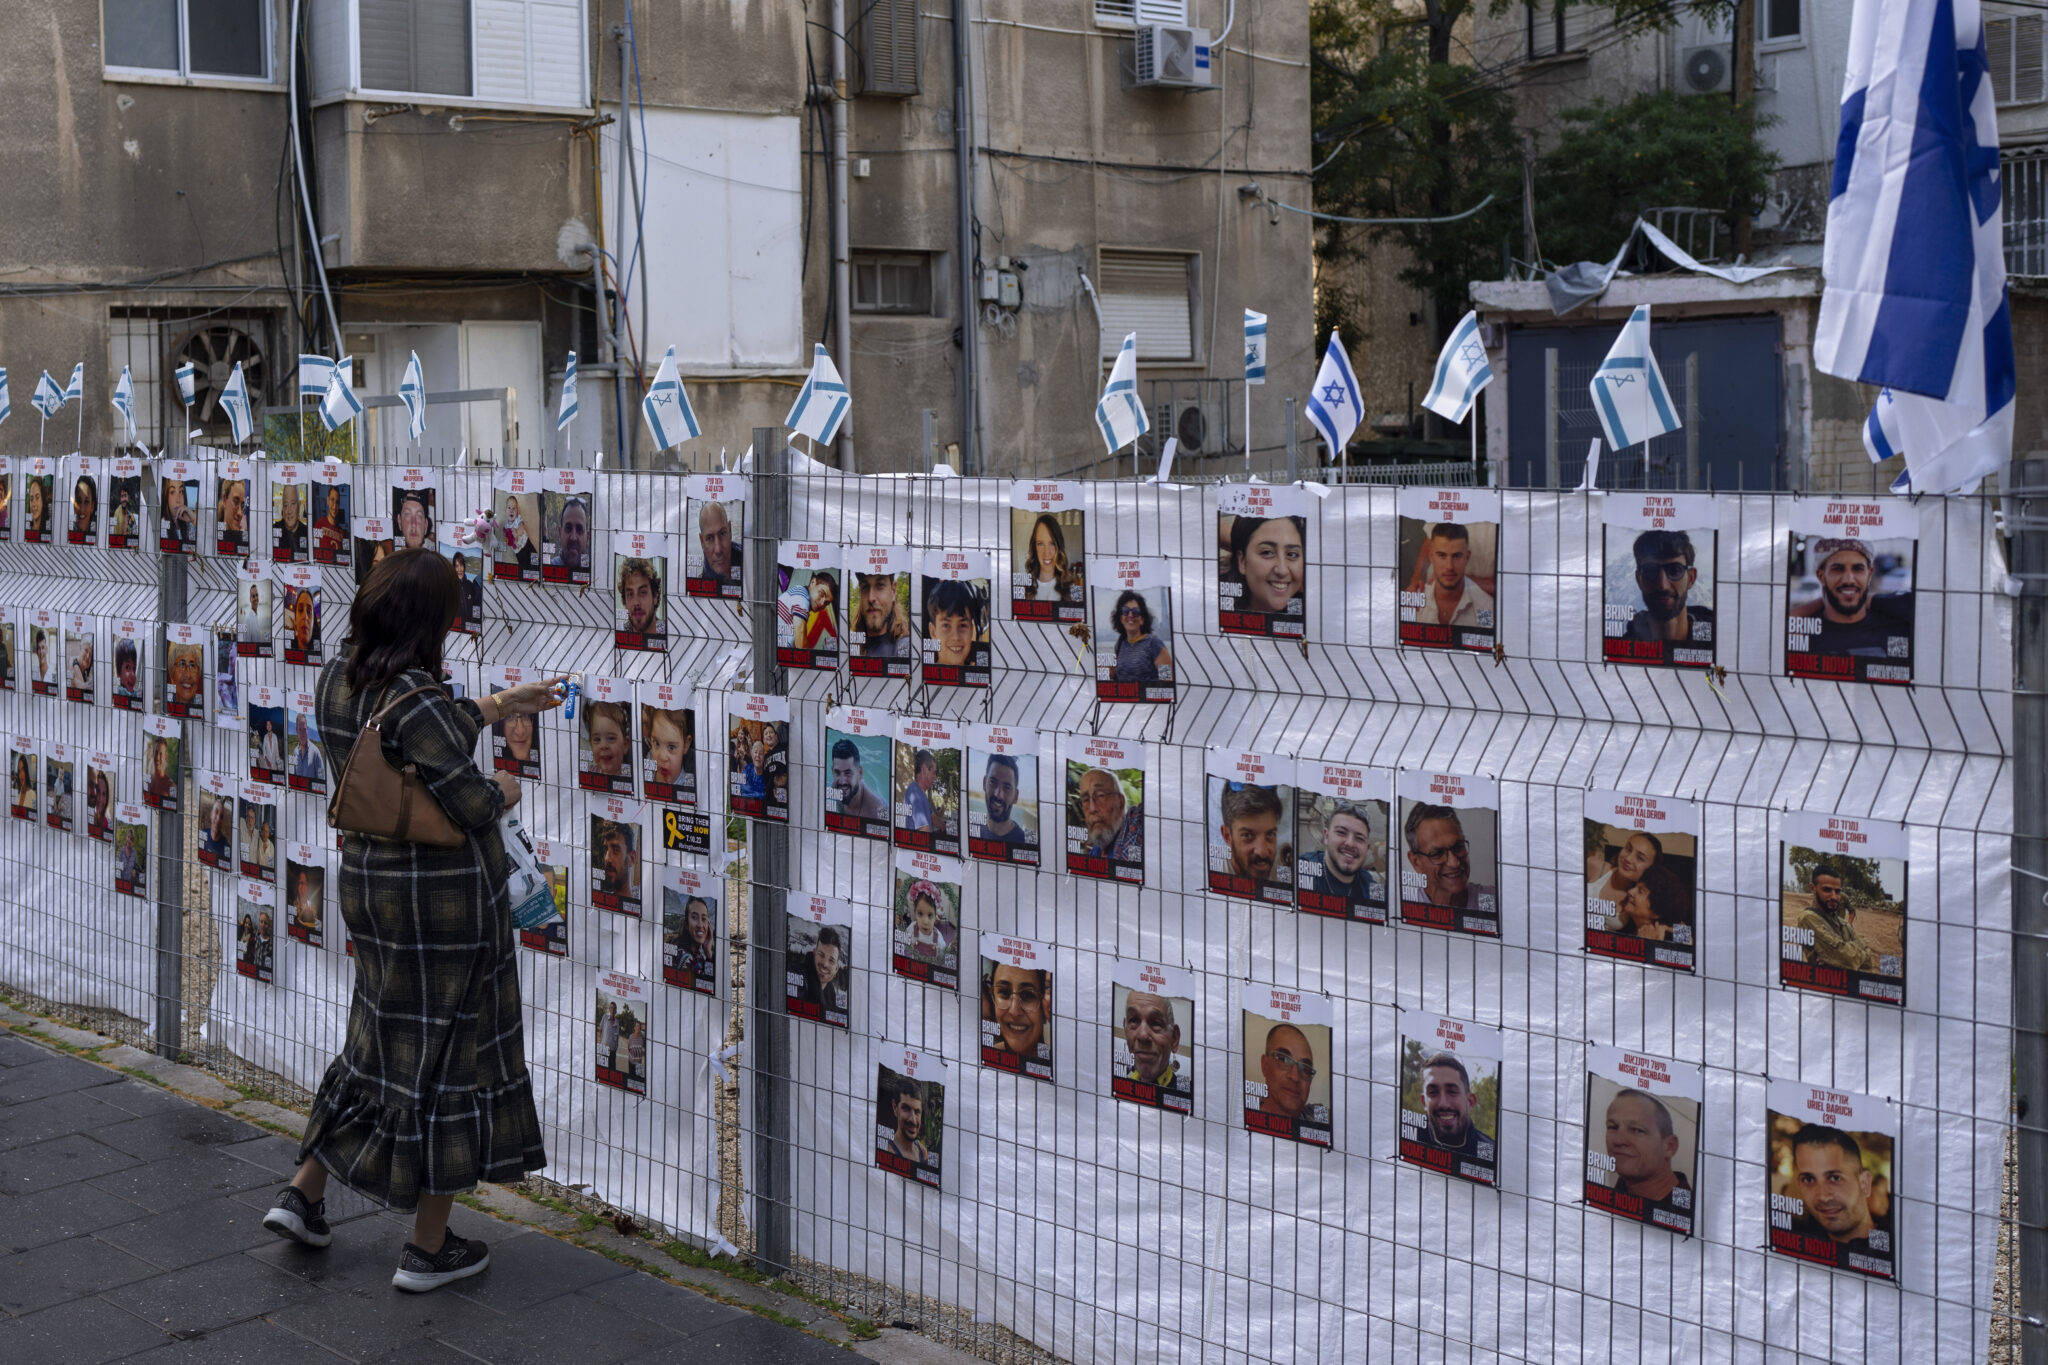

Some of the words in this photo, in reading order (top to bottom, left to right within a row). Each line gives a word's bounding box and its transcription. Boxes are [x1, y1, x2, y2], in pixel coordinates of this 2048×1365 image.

[1440, 502, 1469, 512] SCHERMAN
[1643, 507, 1655, 517] GUY
[1656, 507, 1675, 518] ILLOUZ
[1849, 504, 1860, 514] אבו
[1824, 514, 1843, 525] AAMR
[1845, 515, 1858, 525] ABU
[1860, 516, 1883, 527] SABILH
[1846, 526, 1860, 537] (25)
[1012, 573, 1032, 587] BRING
[1012, 586, 1026, 601] HER
[1219, 581, 1243, 597] BRING
[1219, 596, 1234, 611] HER
[1400, 591, 1425, 608] BRING
[1400, 606, 1416, 622] HIM
[1604, 604, 1634, 621] BRING
[1219, 612, 1241, 628] HOME
[1242, 614, 1266, 631] NOW!
[1604, 620, 1623, 638] HIM
[1788, 616, 1822, 636] BRING
[1400, 623, 1423, 641] HOME
[1424, 625, 1452, 644] NOW!
[923, 638, 941, 651] BRING
[1604, 639, 1631, 657] HOME
[1633, 640, 1663, 660] NOW!
[1788, 633, 1809, 652] HIM
[923, 651, 935, 664] HIM
[1096, 652, 1117, 668] BRING
[1788, 653, 1819, 674] HOME
[1821, 655, 1855, 677] NOW!
[1097, 667, 1111, 681] HER
[1323, 776, 1339, 786] ALMOG
[1340, 778, 1352, 788] MEIR
[1353, 779, 1362, 788] JAN
[1444, 785, 1465, 796] KAPLUN
[969, 811, 988, 826] BRING
[1615, 805, 1634, 816] SAHAR
[1635, 807, 1666, 820] KALDERON
[694, 825, 709, 835] NOW
[969, 823, 981, 838] HIM
[1634, 818, 1645, 829] (16)
[1067, 825, 1088, 842] BRING
[1819, 828, 1844, 841] NIMROD
[1846, 831, 1867, 844] COHEN
[1067, 839, 1081, 855] HIM
[1209, 845, 1232, 860] BRING
[1836, 841, 1849, 853] (19)
[1209, 857, 1224, 873] HIM
[1298, 859, 1323, 878] BRING
[1209, 873, 1231, 890] HOME
[1232, 876, 1256, 896] NOW!
[1298, 874, 1314, 891] HIM
[1401, 871, 1427, 889] BRING
[1298, 890, 1321, 908] HOME
[1322, 893, 1346, 913] NOW!
[1401, 886, 1419, 903] HIM
[1402, 901, 1426, 920] HOME
[1428, 905, 1454, 926] NOW!
[1587, 896, 1616, 917] BRING
[1587, 914, 1606, 931] HER
[1587, 930, 1614, 951] HOME
[1615, 935, 1645, 957] NOW!
[1782, 926, 1815, 946] BRING
[1782, 943, 1803, 962] HIM
[1782, 961, 1813, 983] HOME
[1814, 967, 1848, 990] NOW!
[982, 1019, 1001, 1036] BRING
[1437, 1028, 1446, 1037] ORI
[982, 1033, 994, 1048] HER
[1444, 1039, 1455, 1051] (24)
[1113, 1050, 1135, 1066] BRING
[1113, 1062, 1128, 1079] HIM
[1618, 1062, 1639, 1076] MISHEL
[1113, 1076, 1133, 1097] HOME
[1134, 1082, 1156, 1102] NOW!
[1245, 1080, 1268, 1098] BRING
[1637, 1077, 1649, 1090] (59)
[1245, 1094, 1260, 1111] HIM
[1806, 1098, 1825, 1112] URIEL
[1825, 1102, 1853, 1118] BARUCH
[1245, 1108, 1267, 1129] HOME
[1268, 1113, 1292, 1135] NOW!
[1401, 1108, 1427, 1130] BRING
[1822, 1112, 1836, 1126] (35)
[1401, 1124, 1418, 1142] HIM
[1401, 1140, 1425, 1161] HOME
[1426, 1147, 1452, 1171] NOW!
[1587, 1149, 1617, 1172] BRING
[1587, 1167, 1606, 1186] HIM
[1586, 1182, 1613, 1207] HOME
[1614, 1190, 1643, 1215] NOW!
[1771, 1193, 1804, 1217] BRING
[1771, 1210, 1792, 1231] HIM
[1772, 1228, 1802, 1253] HOME
[1803, 1235, 1837, 1261] NOW!
